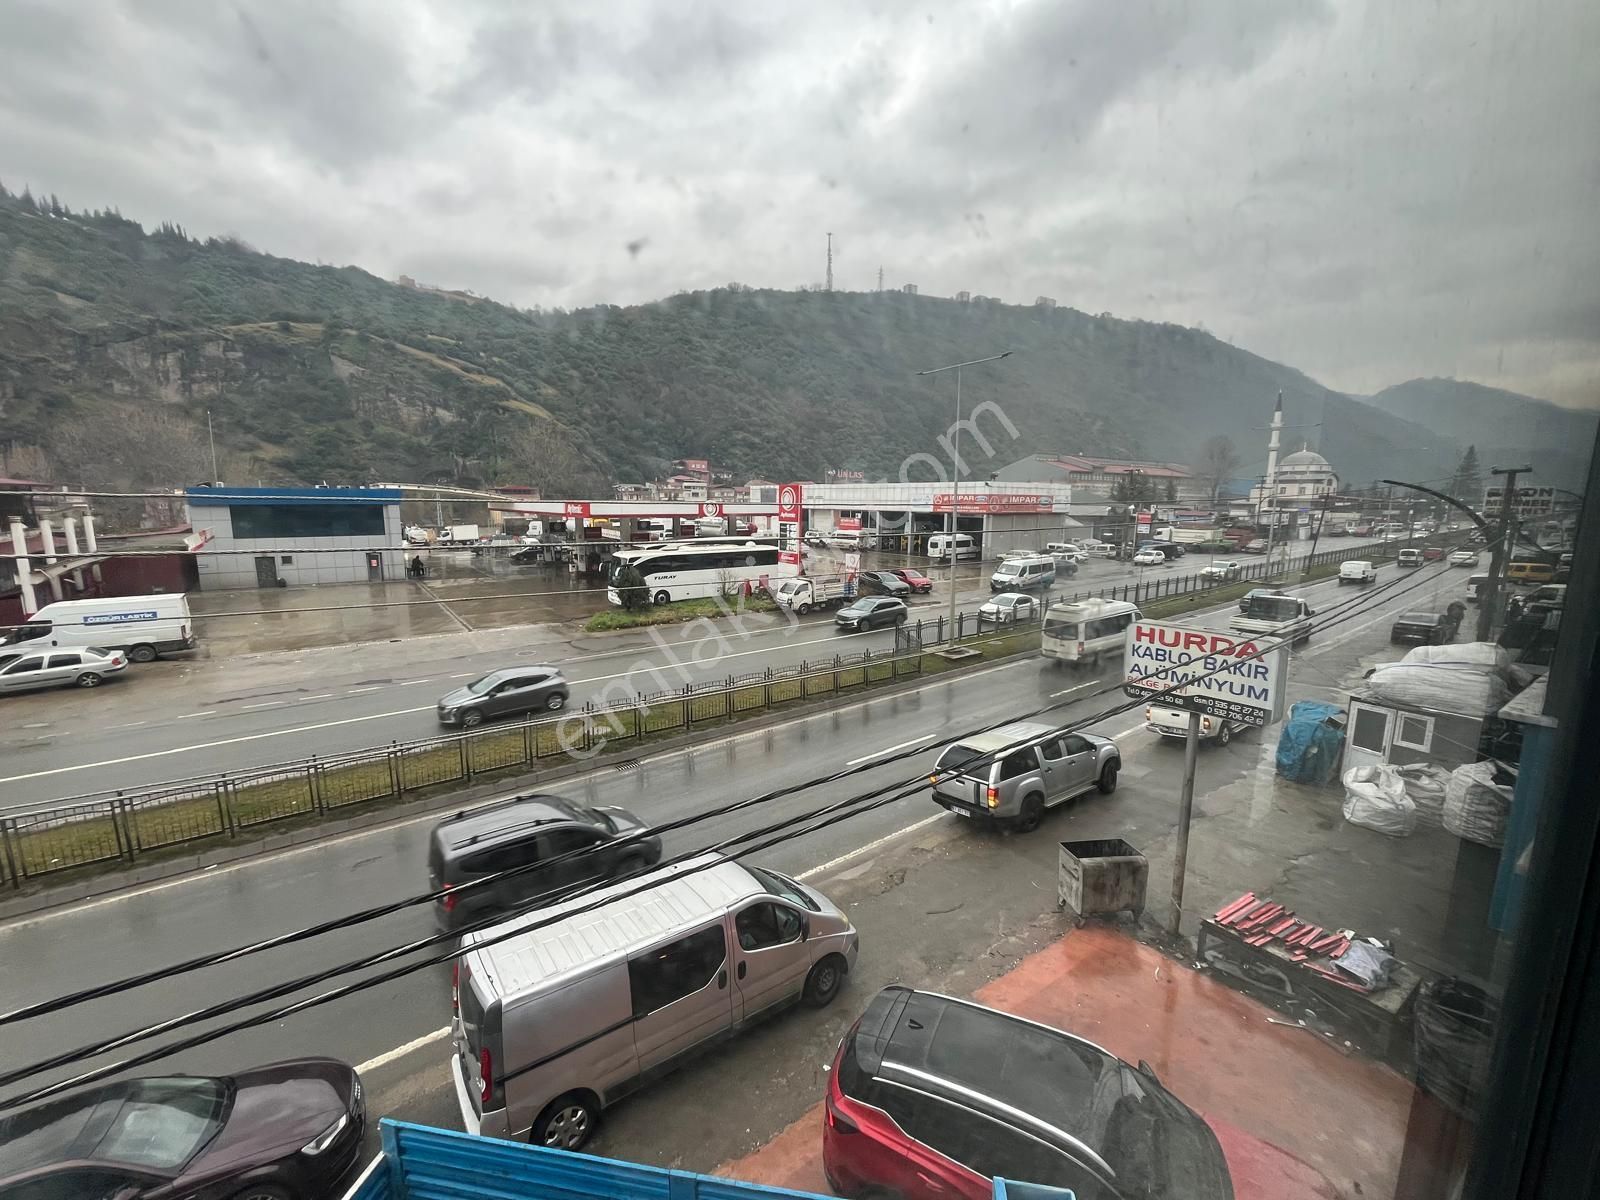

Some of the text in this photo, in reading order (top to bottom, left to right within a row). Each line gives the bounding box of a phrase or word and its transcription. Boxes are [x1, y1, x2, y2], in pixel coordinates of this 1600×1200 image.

[1136, 625, 1265, 662] HURDA
[1131, 644, 1269, 681] KABLO BAKIR
[1193, 696, 1207, 705] Gsm
